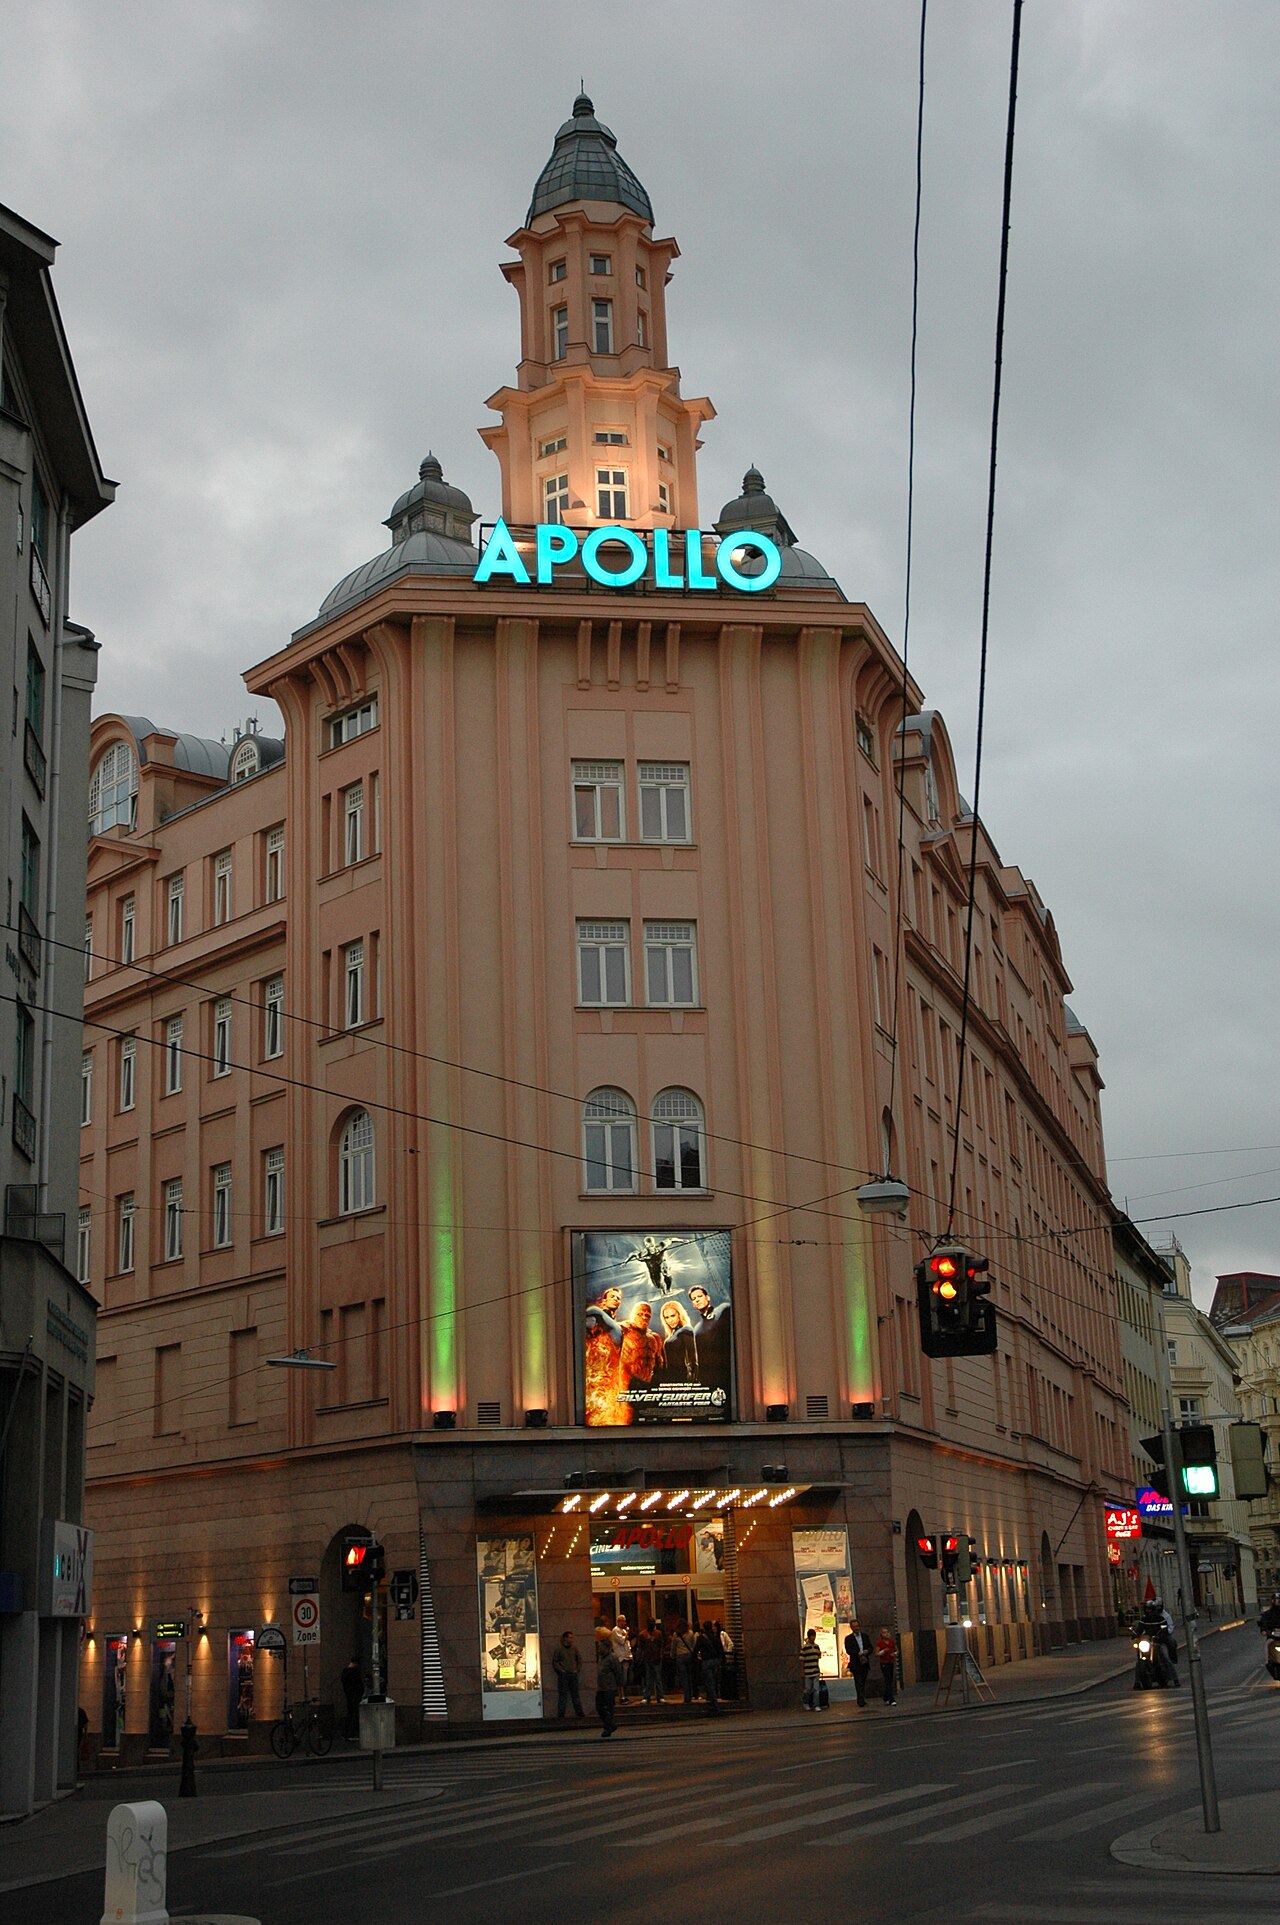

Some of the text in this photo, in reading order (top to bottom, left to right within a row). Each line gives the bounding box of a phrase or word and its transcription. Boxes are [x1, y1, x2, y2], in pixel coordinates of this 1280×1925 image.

[472, 515, 782, 593] APOLLO
[617, 1392, 712, 1401] SILVER SURFER
[611, 1525, 693, 1549] APOLLO
[300, 1606, 312, 1620] 30
[297, 1630, 317, 1642] Zone
